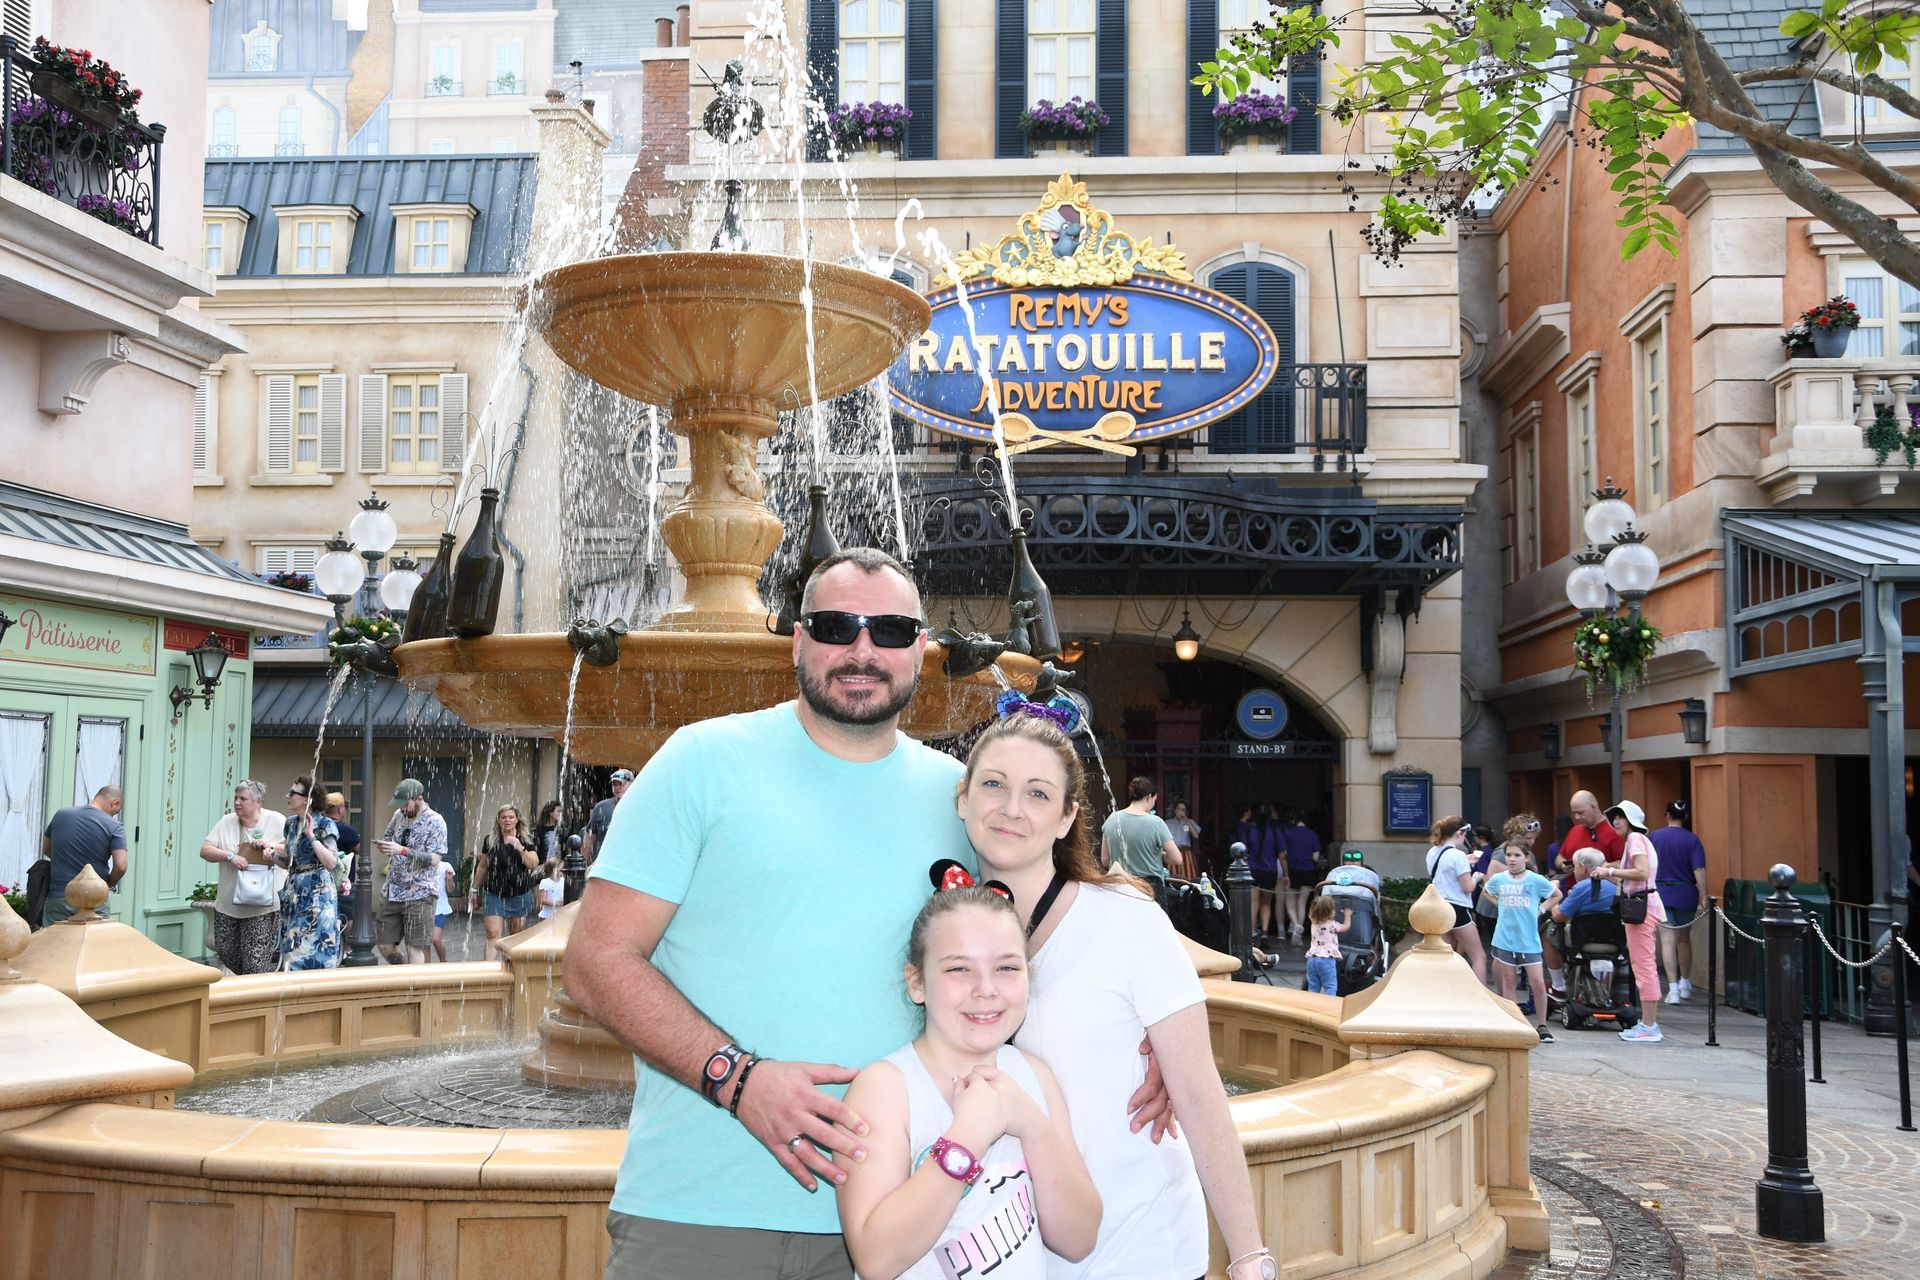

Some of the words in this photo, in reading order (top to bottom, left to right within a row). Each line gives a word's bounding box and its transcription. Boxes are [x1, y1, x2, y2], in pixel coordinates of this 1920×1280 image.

[1009, 292, 1130, 332] REMY'S
[909, 332, 1227, 374] RATATOUILLE
[19, 609, 122, 654] Pâtisserie
[1237, 744, 1287, 754] STAND-BY
[1500, 884, 1524, 895] STAY
[1501, 895, 1531, 907] WEIRD
